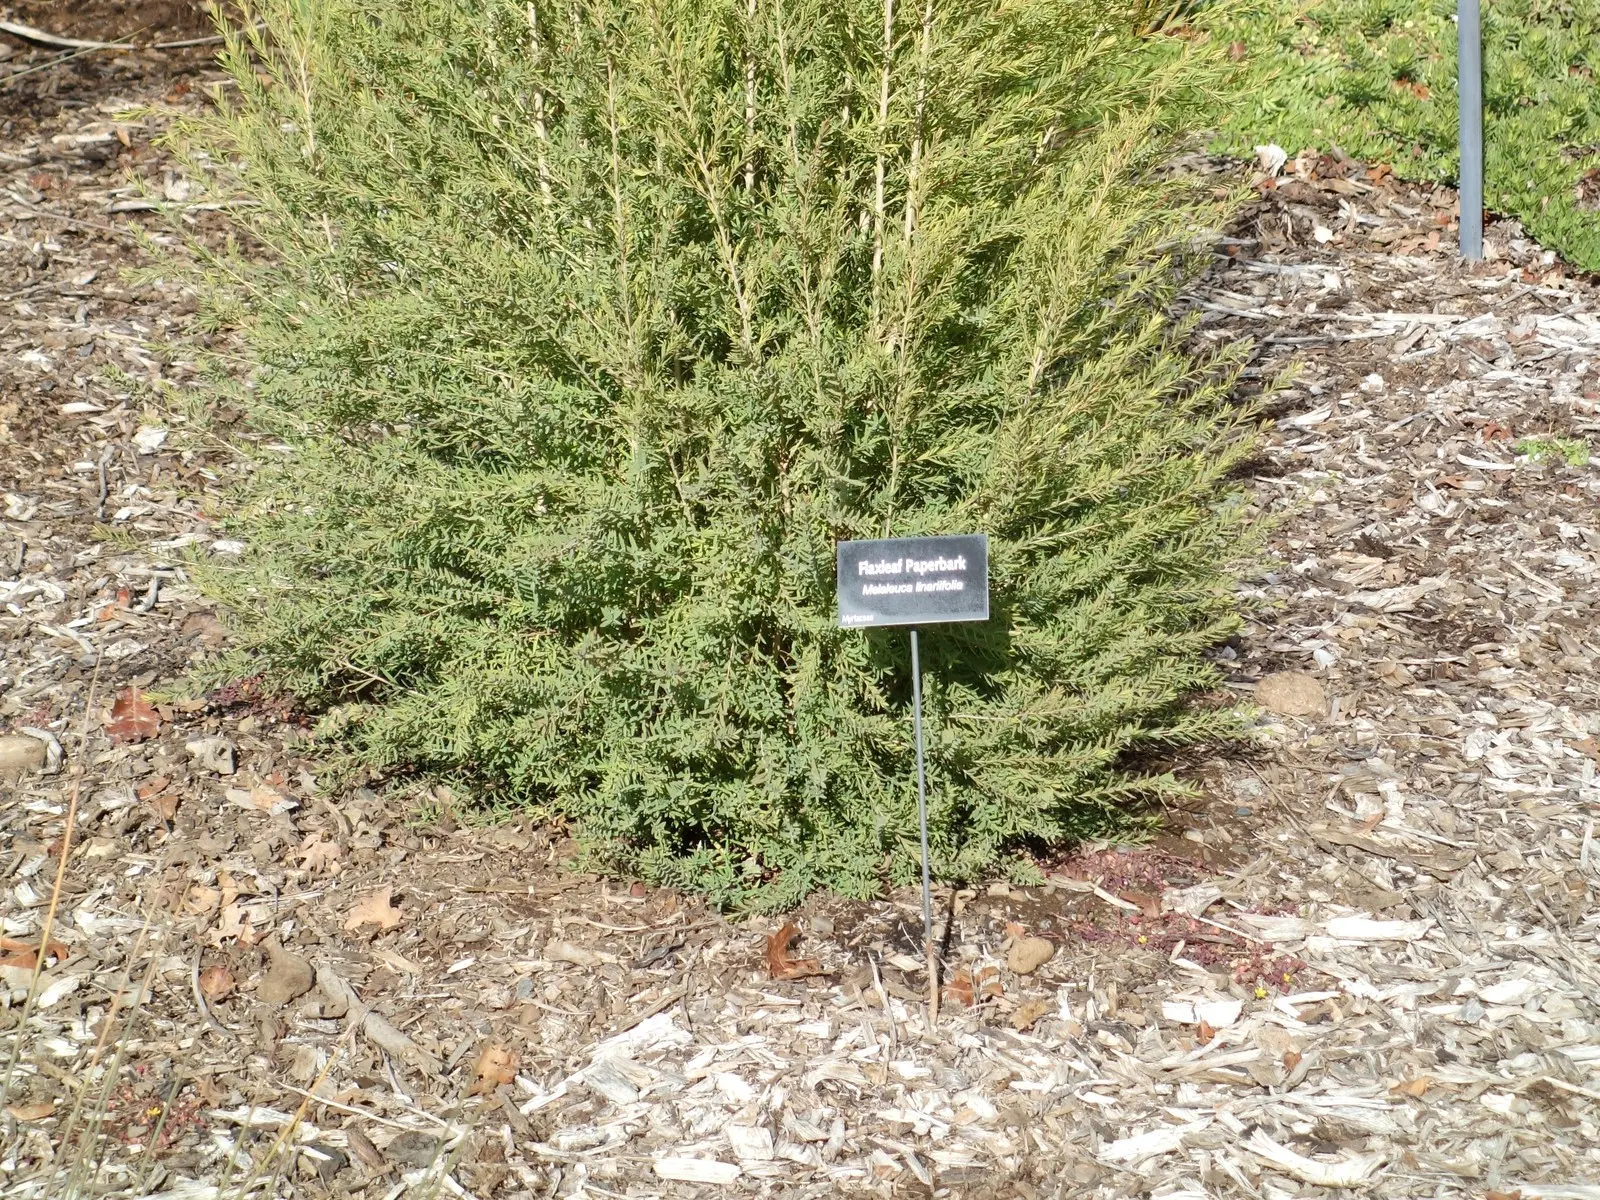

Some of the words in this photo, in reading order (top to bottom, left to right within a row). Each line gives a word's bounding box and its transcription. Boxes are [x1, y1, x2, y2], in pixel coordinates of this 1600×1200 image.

[858, 558, 903, 575] Flaxleaf
[905, 555, 967, 575] Paperbark
[862, 582, 913, 595] Melaleuca
